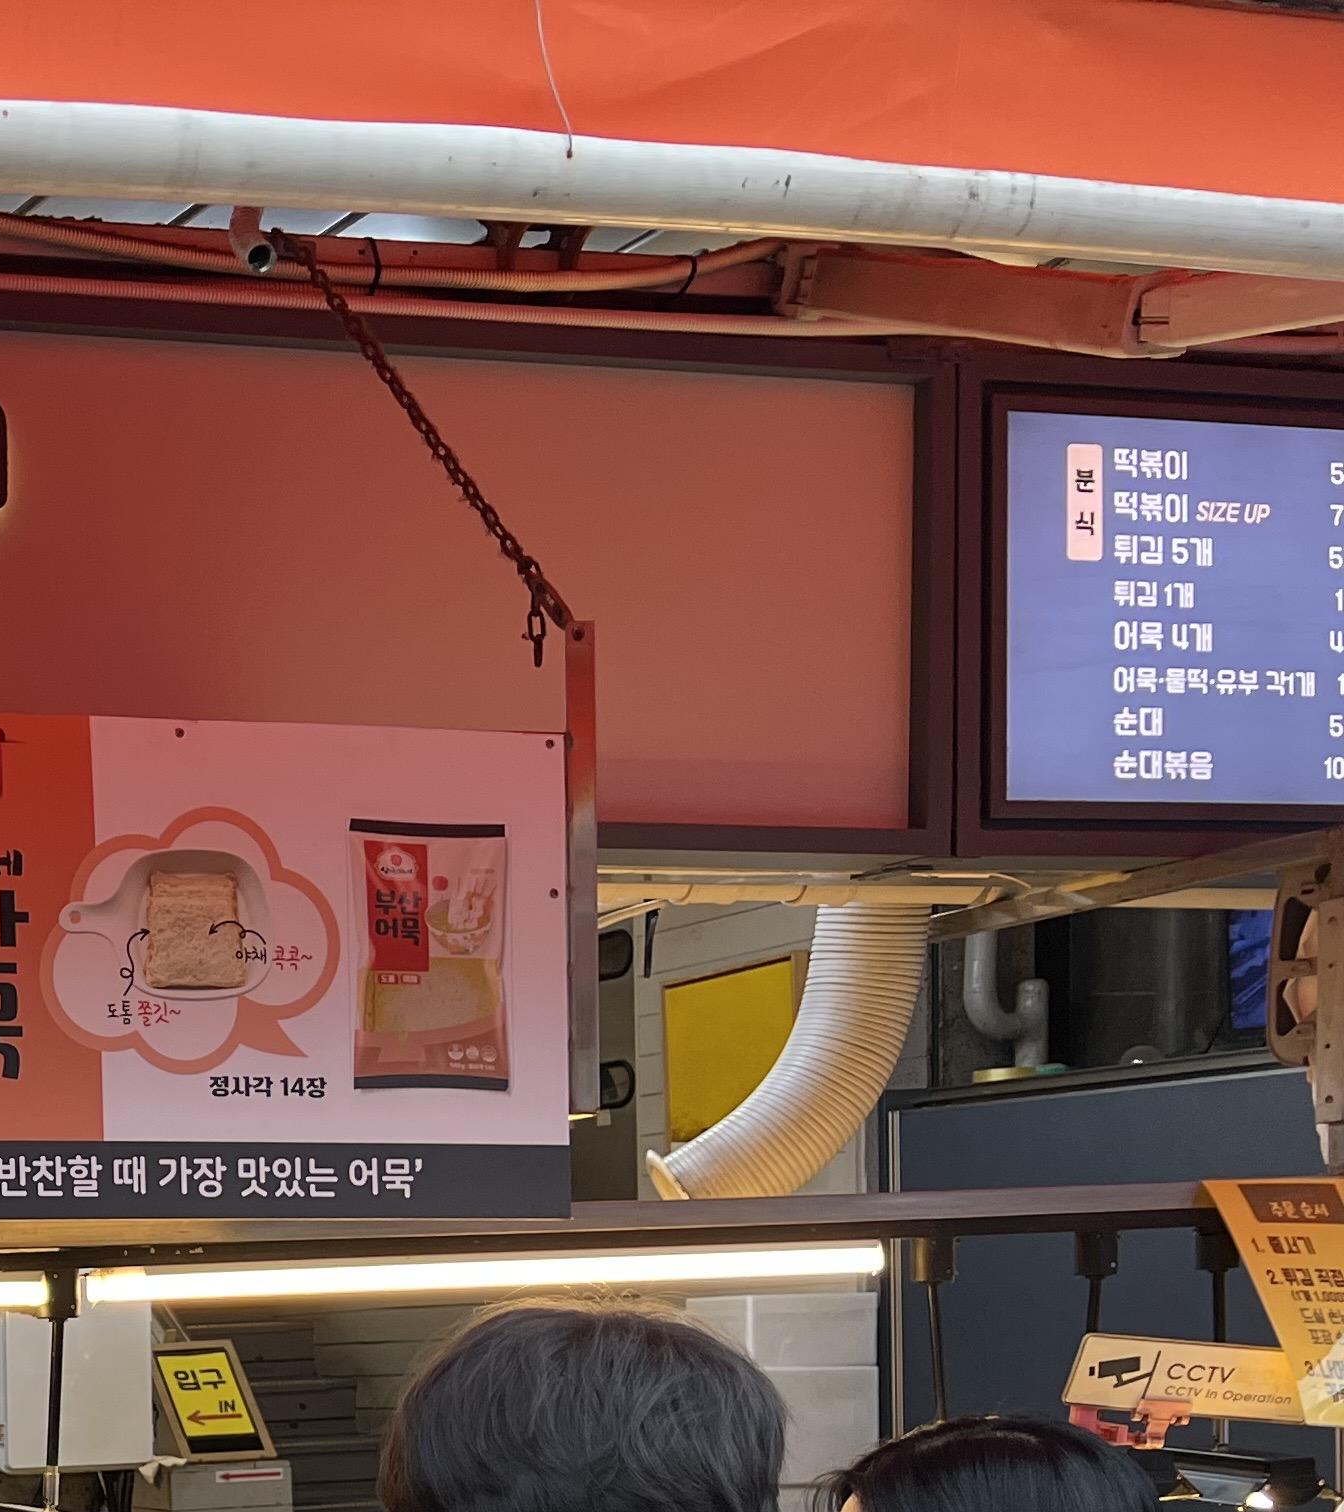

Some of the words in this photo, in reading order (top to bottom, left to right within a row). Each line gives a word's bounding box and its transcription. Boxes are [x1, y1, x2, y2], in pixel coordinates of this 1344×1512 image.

[1114, 448, 1188, 481] 떡볶이
[1114, 491, 1188, 523] 떡볶이
[1196, 500, 1240, 523] SIZE
[1244, 502, 1271, 524] UP
[1114, 534, 1163, 566] 튀김
[1172, 536, 1214, 568] 5개
[1114, 580, 1157, 608] 튀김
[1164, 582, 1195, 610] 1개
[1114, 621, 1163, 651] 어묵
[1172, 622, 1214, 653] 4개
[1114, 707, 1163, 737] 순대
[1114, 750, 1213, 781] 순대볶음
[375, 888, 422, 914] 부산
[374, 916, 420, 946] 어묵
[235, 946, 267, 965] 야채
[107, 1000, 133, 1025] 도톰
[208, 1075, 273, 1099] 정사각
[279, 1076, 328, 1099] 14장
[111, 1157, 147, 1199] 때
[156, 1156, 227, 1199] 가장
[235, 1157, 339, 1200] 맛있는
[174, 1368, 227, 1391] 입구
[1166, 1362, 1237, 1384] CCTV
[218, 1399, 236, 1413] IN
[1164, 1385, 1202, 1399] CCTV
[1223, 1389, 1292, 1406] Operation
